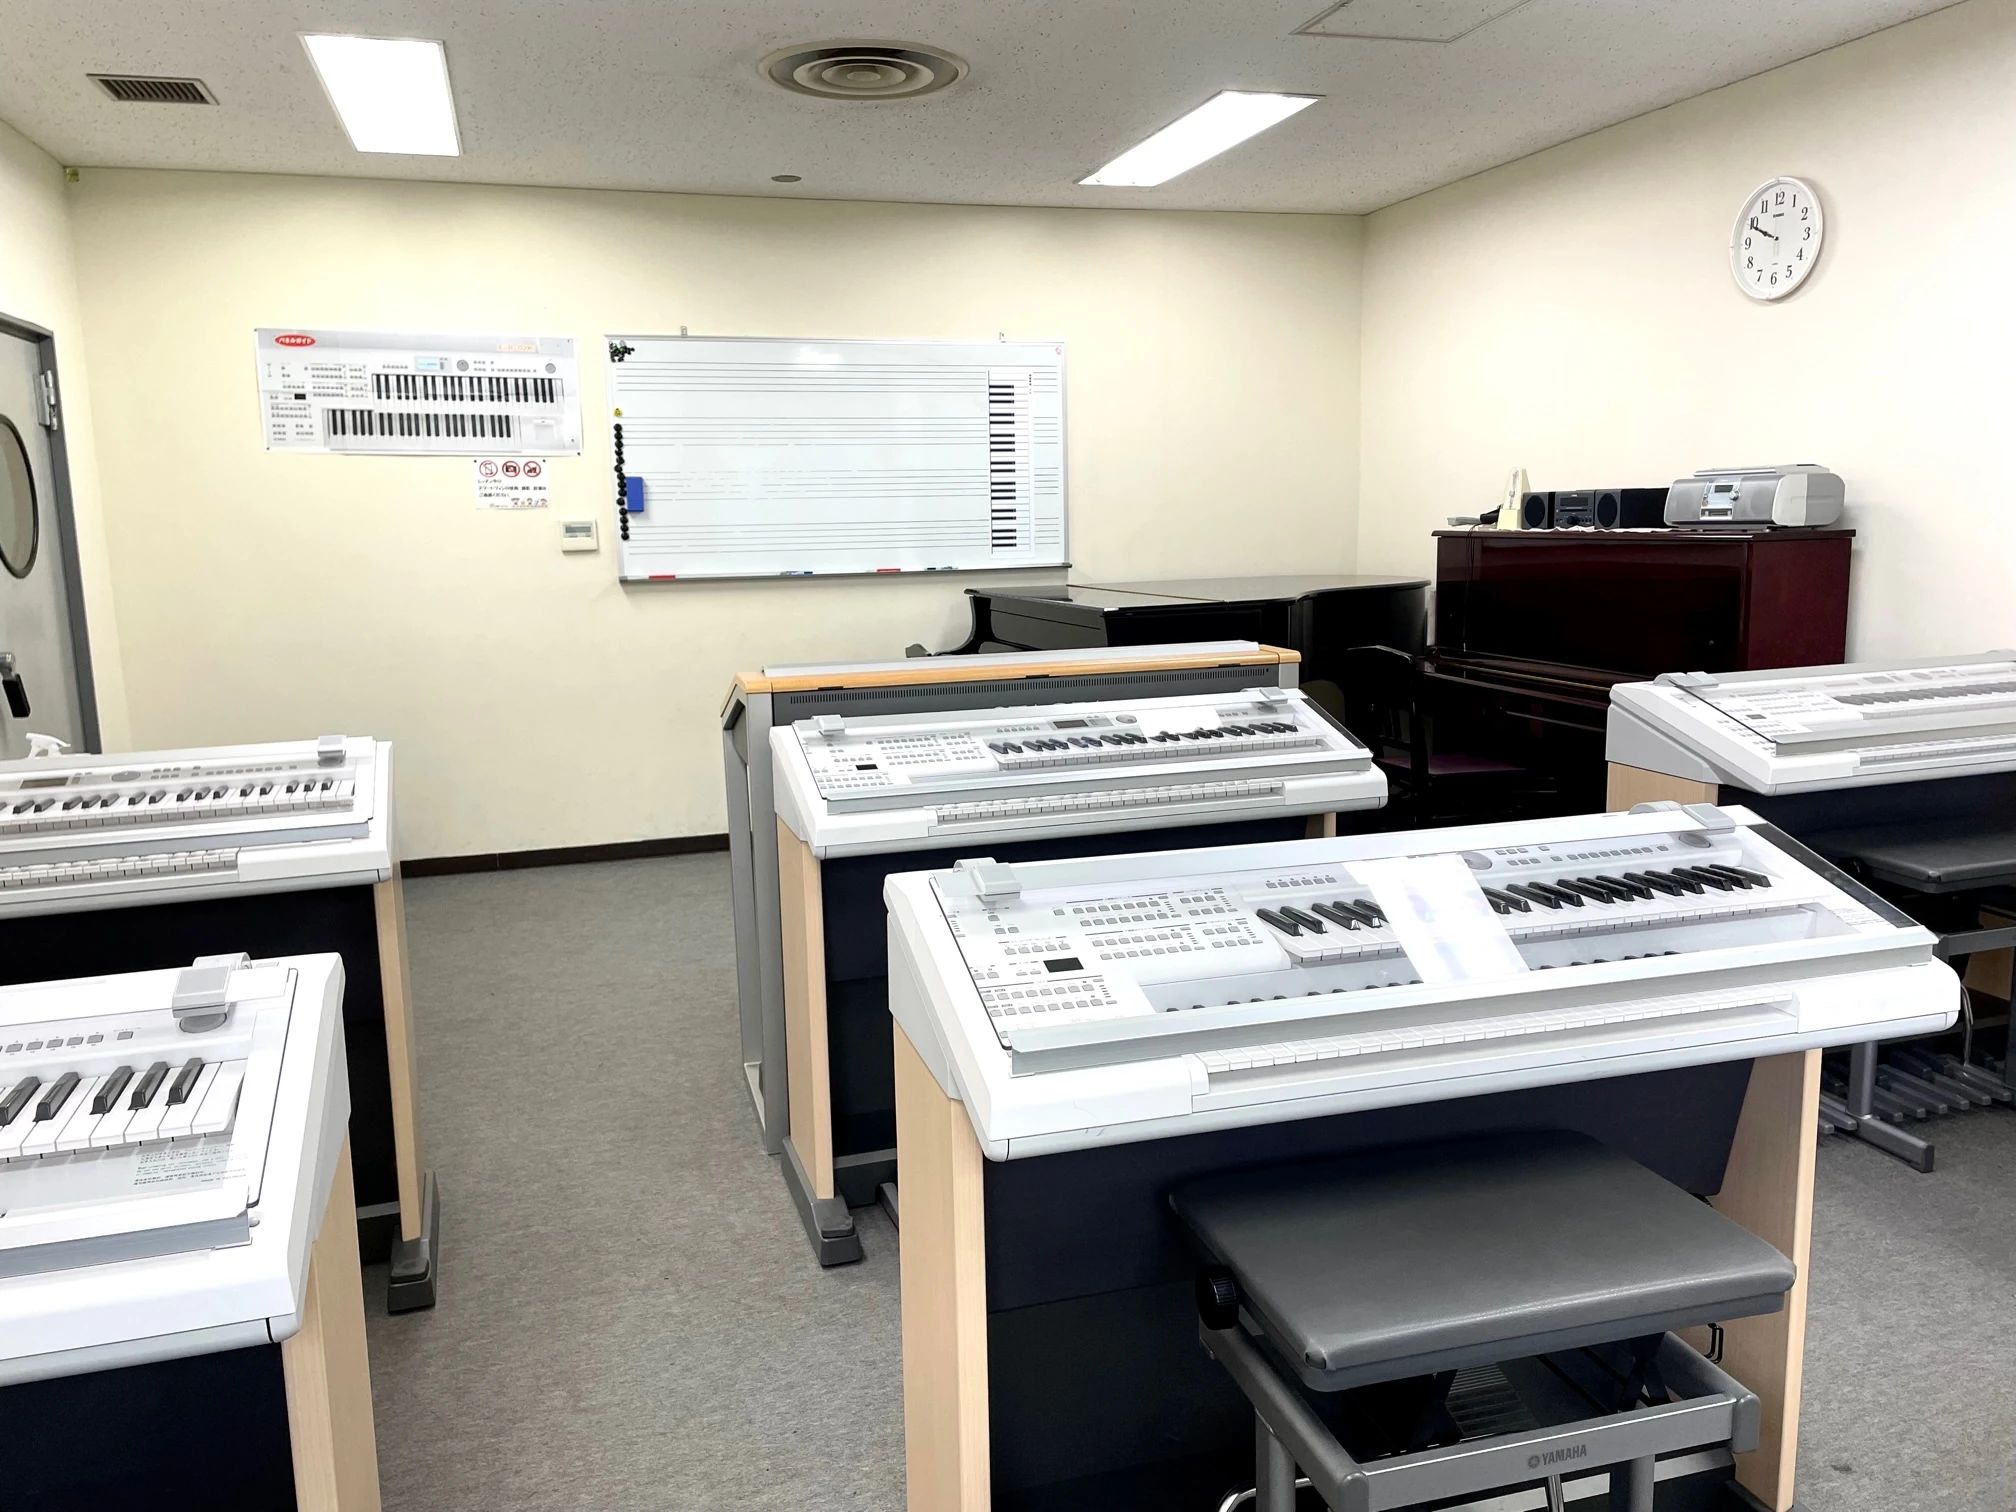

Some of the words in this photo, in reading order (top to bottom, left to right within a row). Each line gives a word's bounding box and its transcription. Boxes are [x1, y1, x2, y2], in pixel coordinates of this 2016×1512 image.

[1775, 191, 1785, 206] 12
[1792, 194, 1797, 208] 1
[1761, 200, 1768, 213] 11
[1801, 207, 1808, 221] 2
[1750, 216, 1758, 230] 10
[1803, 227, 1811, 240] 3
[1744, 237, 1752, 250] 9
[1796, 247, 1803, 261] 4
[1746, 256, 1754, 269] 8
[1756, 269, 1763, 282] 7
[1785, 265, 1793, 278] 5
[1770, 272, 1777, 285] 6
[1541, 1444, 1587, 1466] YAMAHA
